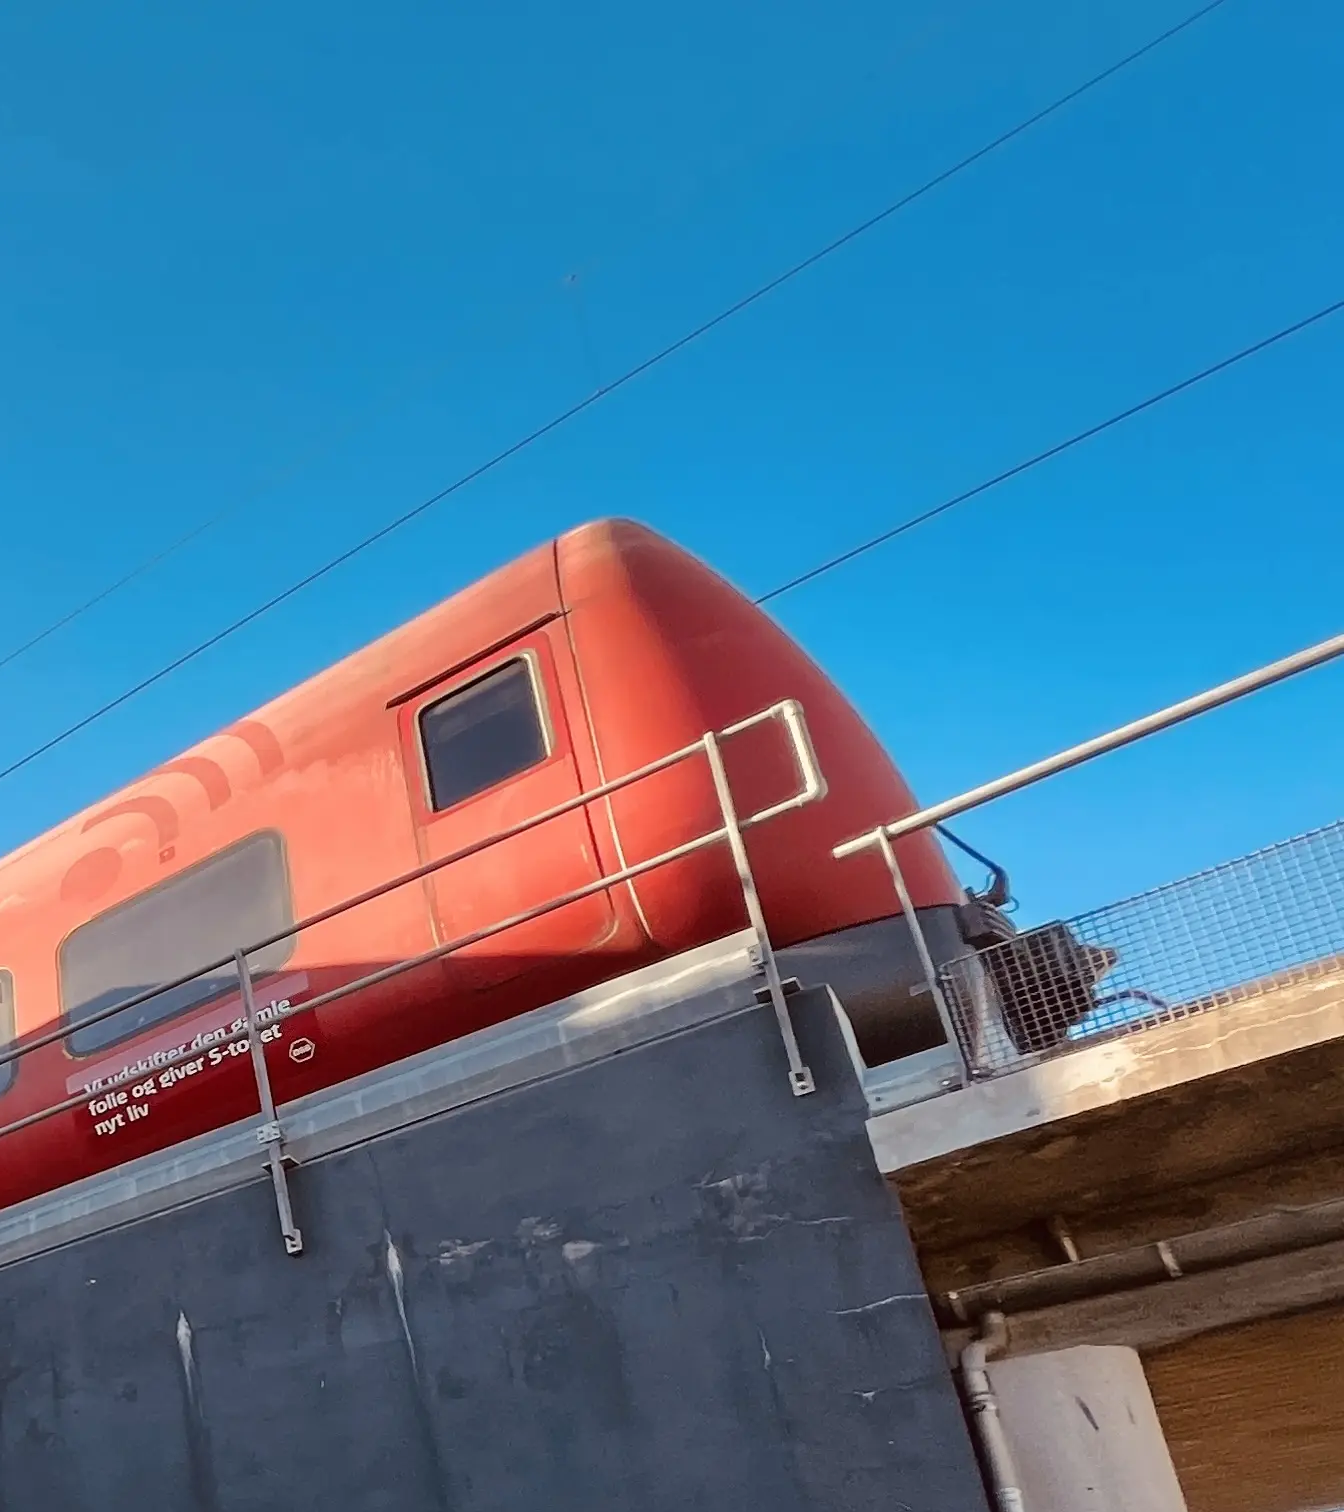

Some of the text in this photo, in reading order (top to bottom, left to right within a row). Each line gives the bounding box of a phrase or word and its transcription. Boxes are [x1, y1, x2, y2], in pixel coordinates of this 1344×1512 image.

[107, 1044, 187, 1087] udskifter
[190, 1027, 227, 1054] den
[132, 1077, 158, 1099] og
[159, 1057, 205, 1089] giver
[208, 1024, 283, 1067] S-toet
[94, 1103, 149, 1136] nyt liv
